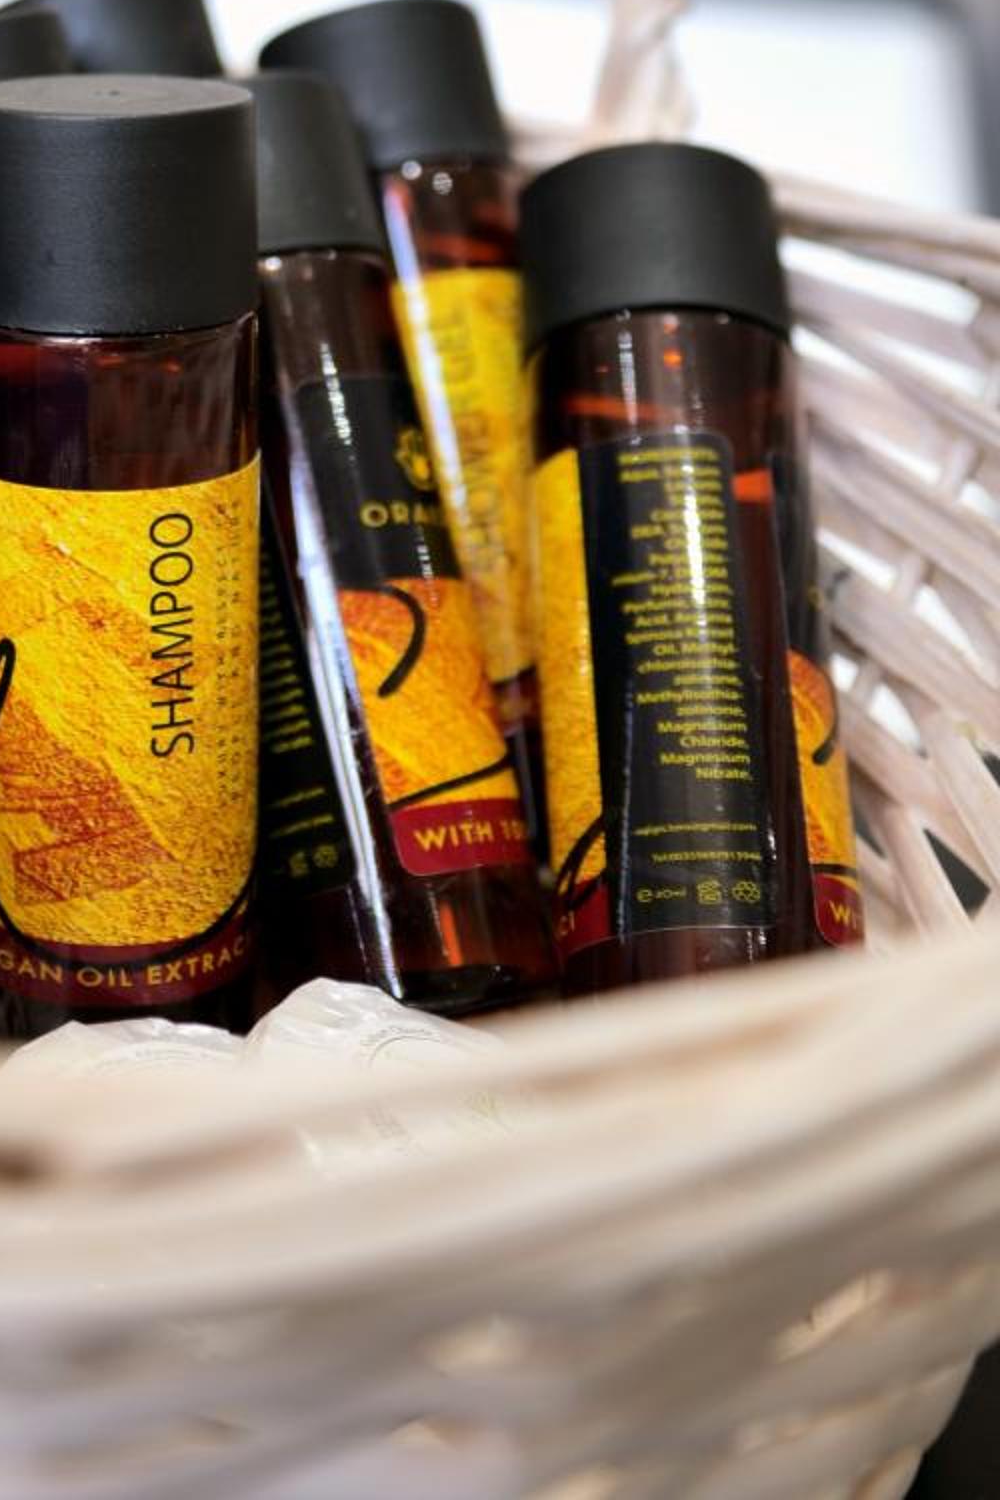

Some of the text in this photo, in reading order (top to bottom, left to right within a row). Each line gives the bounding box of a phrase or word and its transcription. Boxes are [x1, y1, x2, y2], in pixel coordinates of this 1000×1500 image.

[149, 512, 194, 758] SHAMPOO
[413, 821, 494, 852] WITH
[76, 966, 134, 988] OIL
[146, 934, 246, 987] EXTRAC
